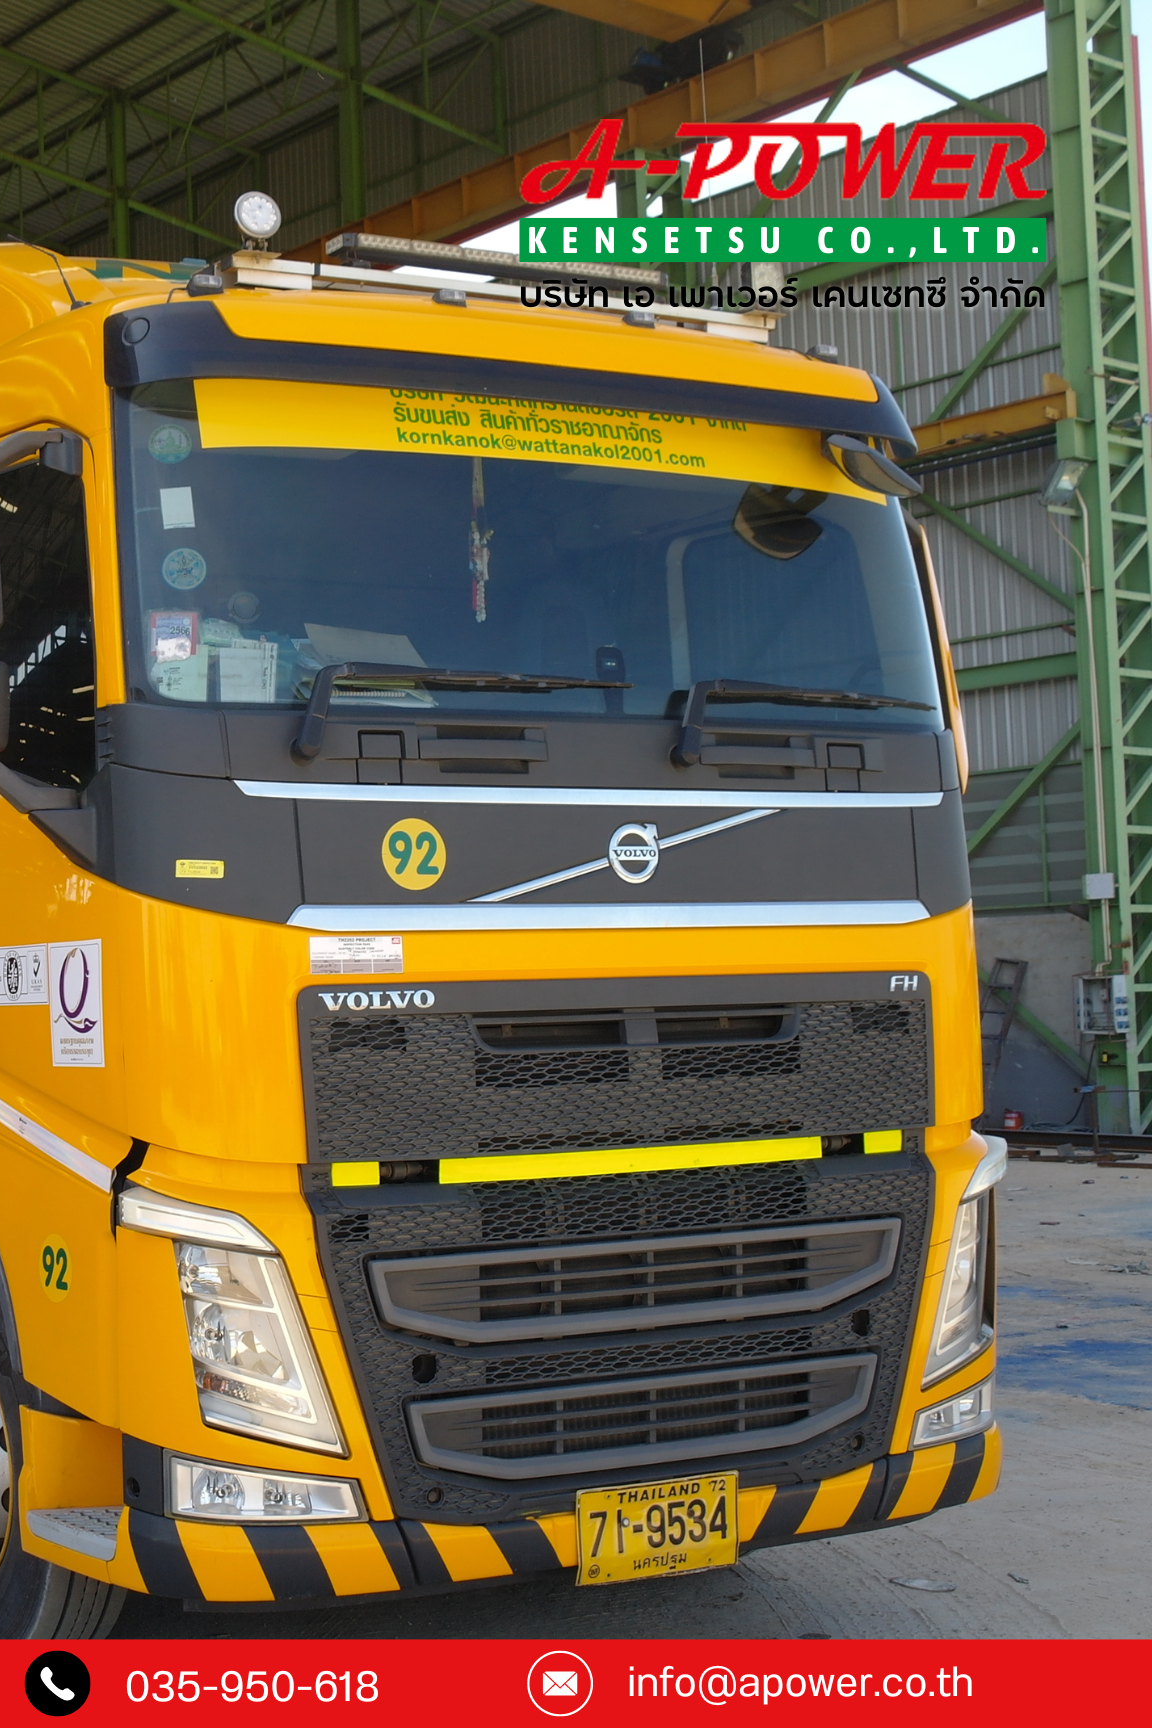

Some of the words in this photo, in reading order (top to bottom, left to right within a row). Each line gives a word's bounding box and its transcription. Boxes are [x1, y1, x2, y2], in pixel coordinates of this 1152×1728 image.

[393, 402, 470, 426] รับขนส่ง
[397, 427, 706, 468] kornkanok@wattanakol2001.com
[169, 626, 191, 637] 2566
[388, 831, 439, 875] 92
[612, 849, 657, 858] VOLVO
[889, 975, 918, 992] FH
[318, 989, 436, 1011] VOLVO
[43, 1246, 68, 1290] 92
[617, 1482, 701, 1504] THAILAND
[589, 1495, 728, 1558] 71-9534
[633, 1552, 687, 1570] นครปฐม
